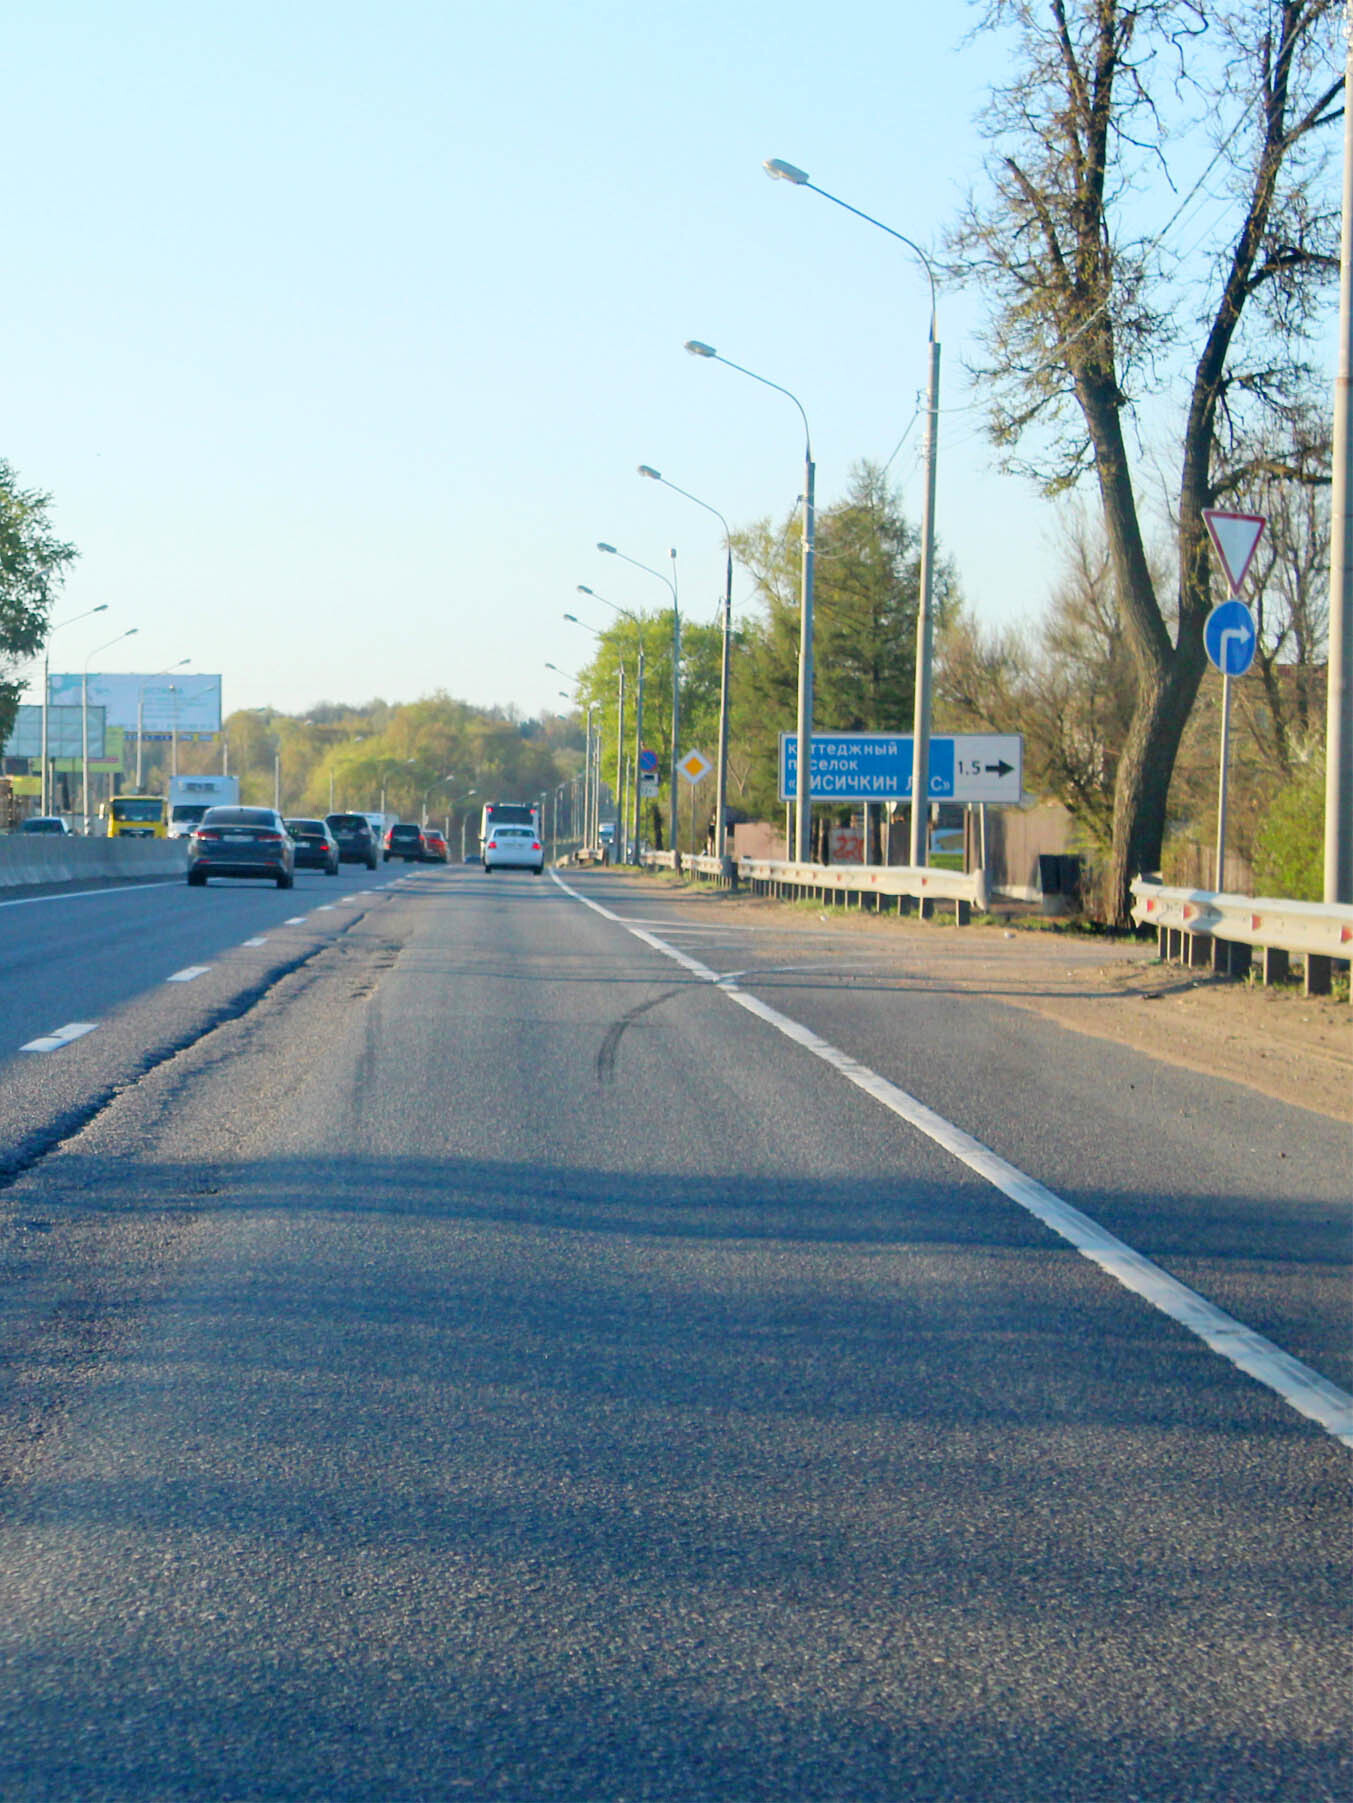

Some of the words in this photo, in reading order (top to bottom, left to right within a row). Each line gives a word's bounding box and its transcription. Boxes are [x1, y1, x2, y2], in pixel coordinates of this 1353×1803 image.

[788, 742, 898, 756] кттеджный
[788, 759, 859, 771] пселок
[788, 774, 897, 791] «ИСИЧКИН
